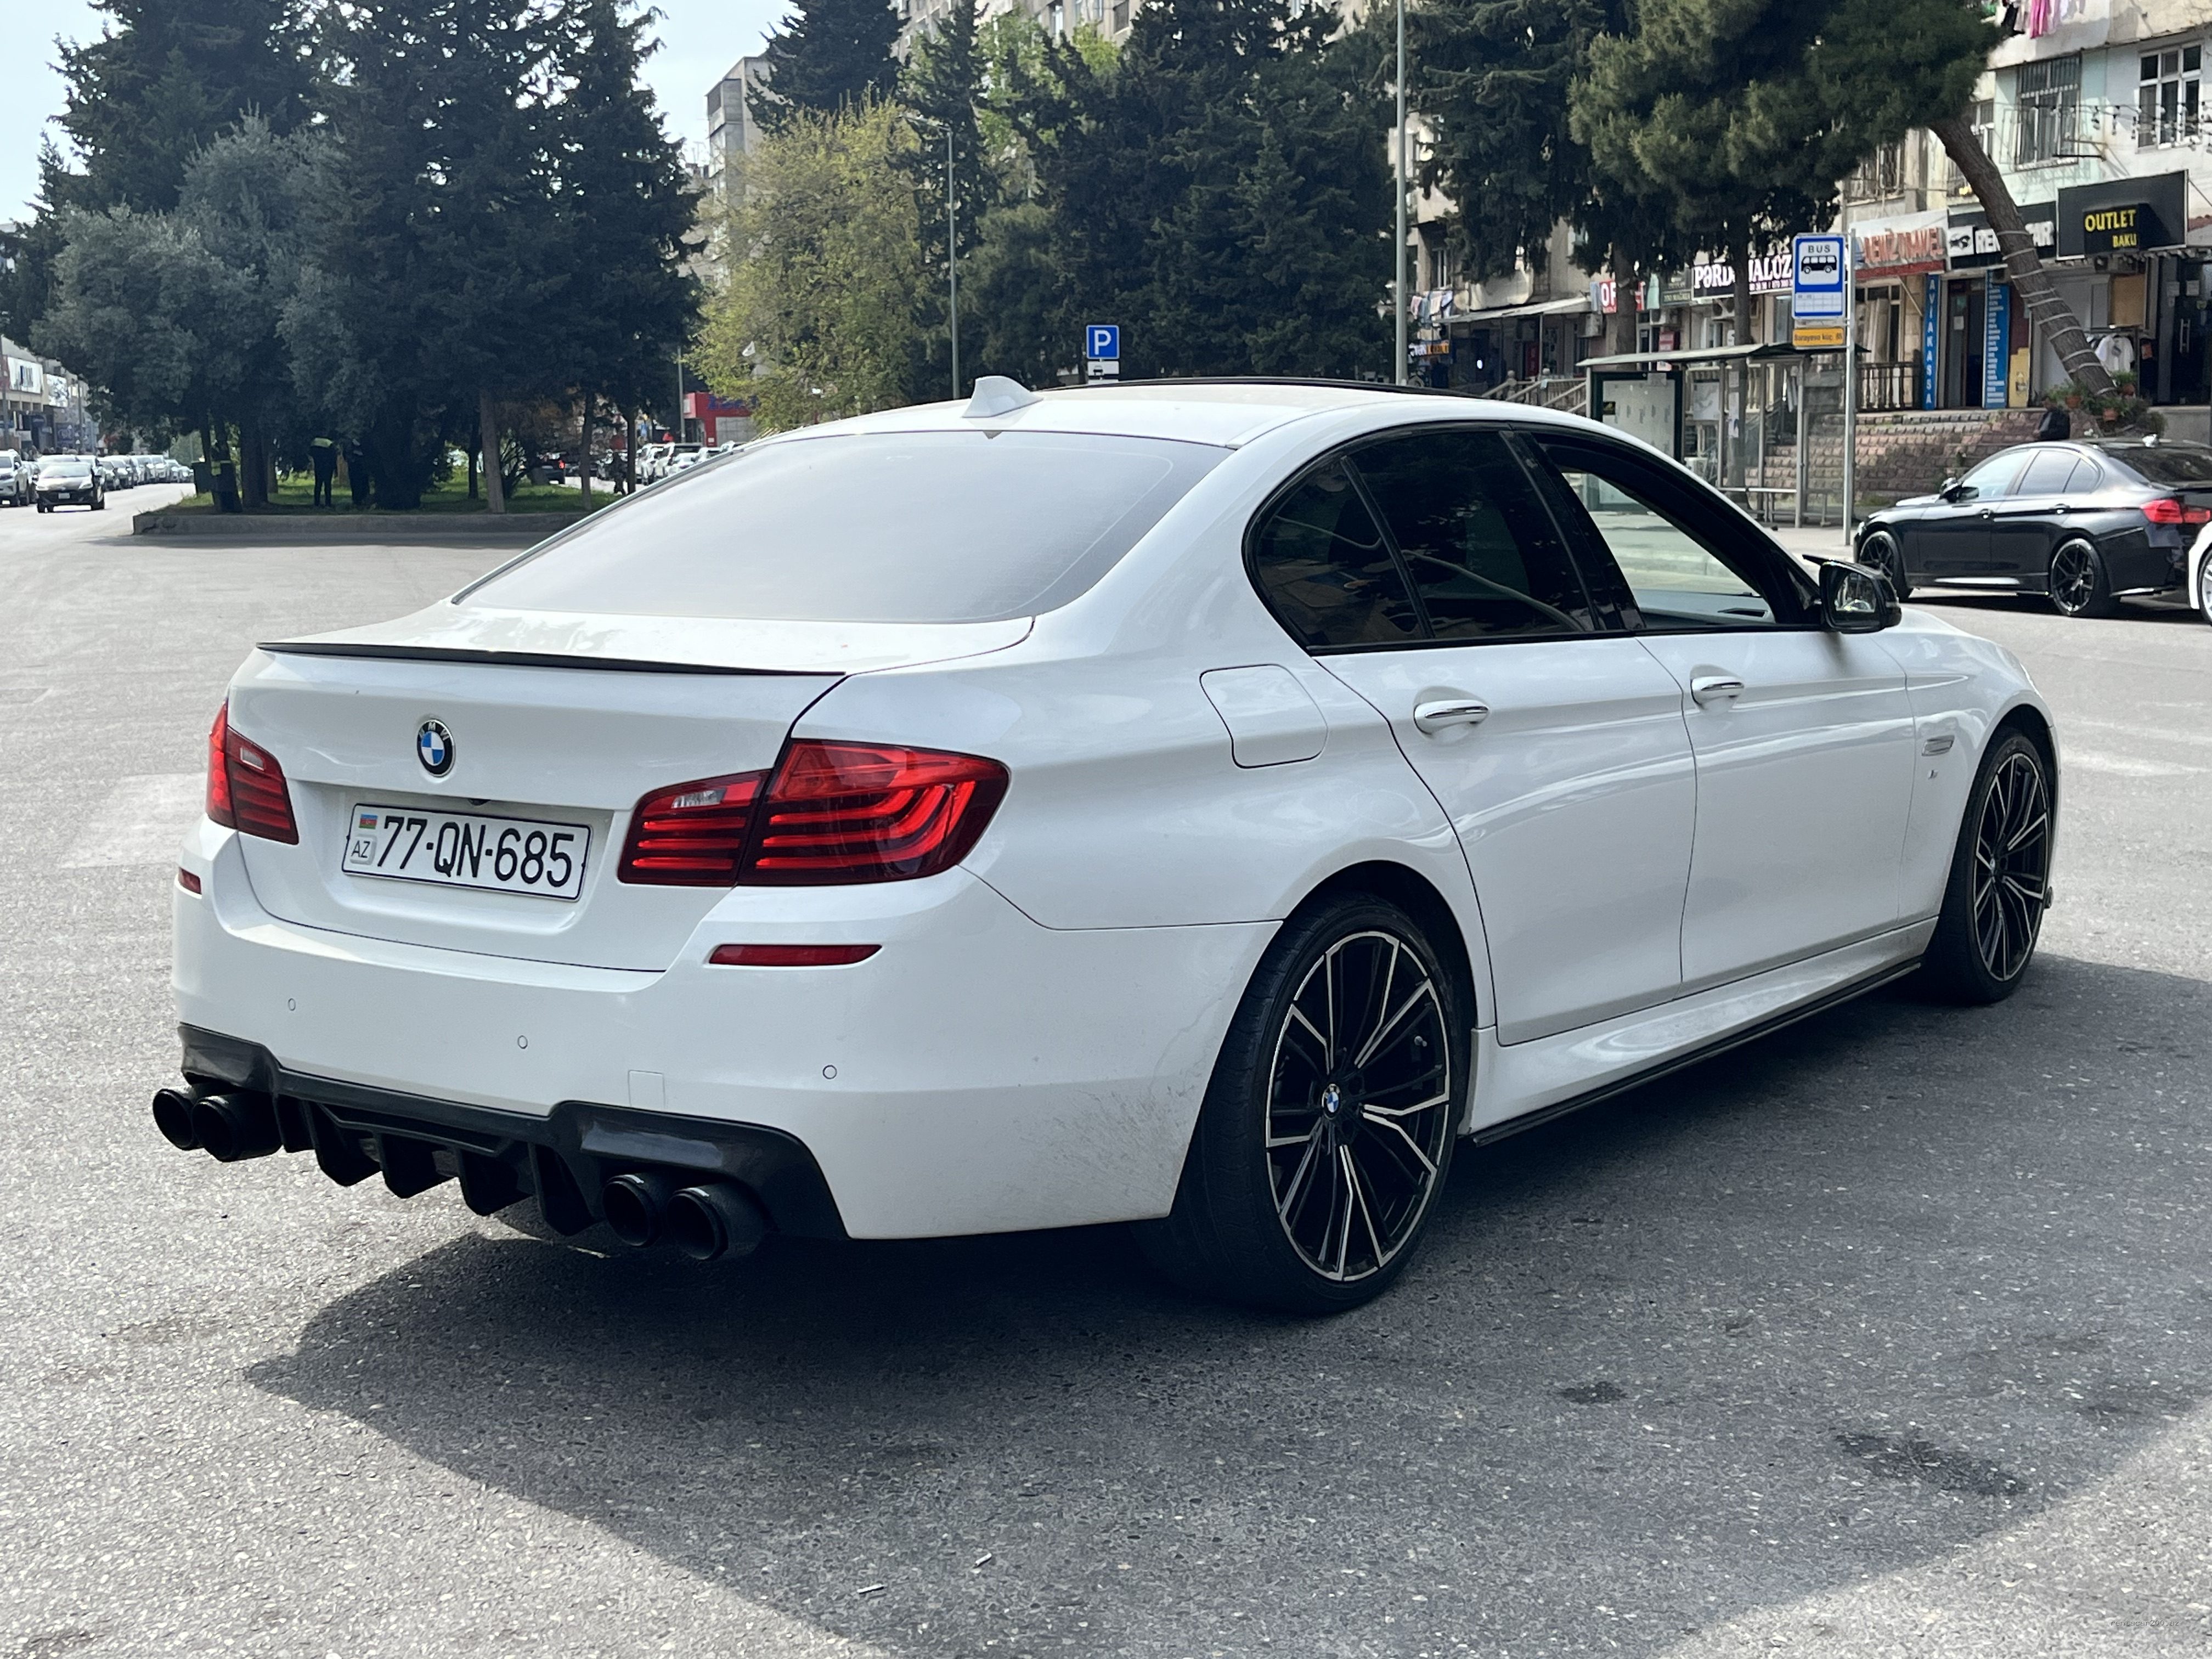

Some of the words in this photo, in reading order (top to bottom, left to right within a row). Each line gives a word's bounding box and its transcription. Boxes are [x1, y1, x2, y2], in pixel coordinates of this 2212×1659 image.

[2085, 210, 2136, 232] OUTLET
[1808, 245, 1831, 253] BUS
[1975, 228, 2001, 254] REN
[2112, 233, 2137, 248] BAKU
[1694, 263, 1735, 289] PƏRD
[1094, 330, 1111, 355] P
[351, 840, 371, 858] AZ
